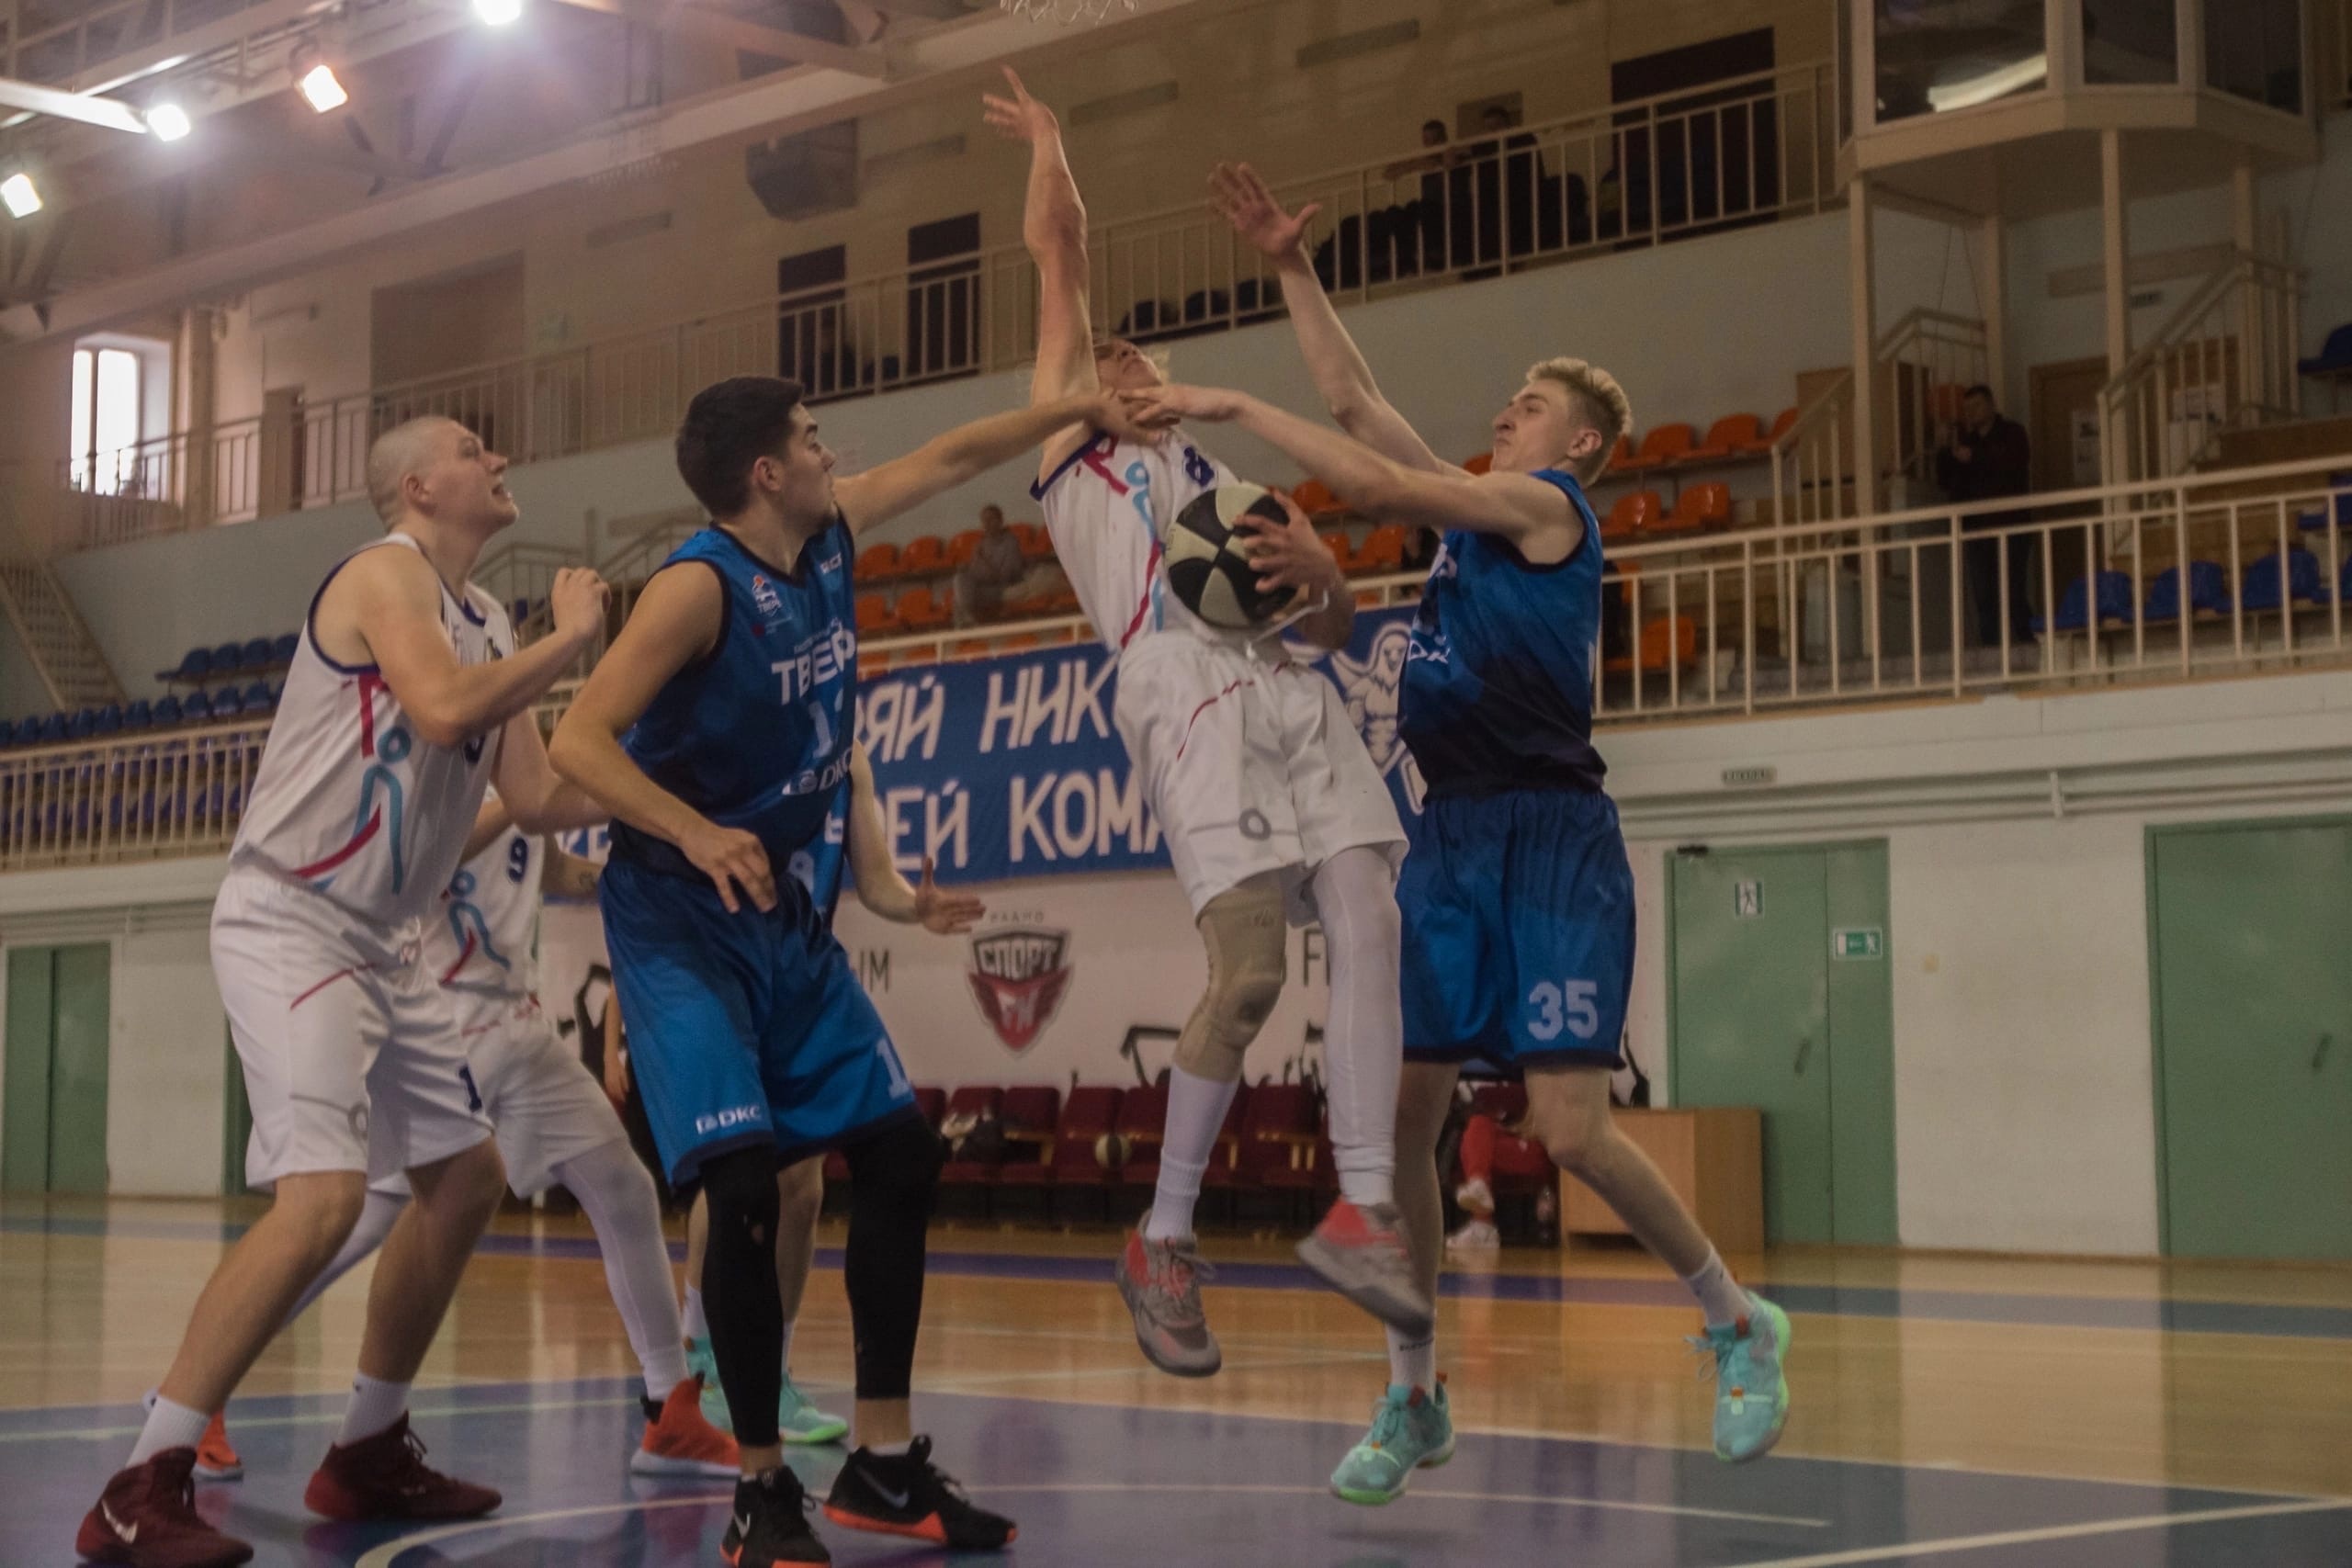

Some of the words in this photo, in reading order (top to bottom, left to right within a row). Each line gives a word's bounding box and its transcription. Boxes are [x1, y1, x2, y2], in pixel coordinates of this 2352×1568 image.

[978, 651, 1118, 753] НИК
[874, 779, 969, 870] ЕЙ
[978, 938, 1059, 981] СПОРТ
[1528, 979, 1598, 1041] 35
